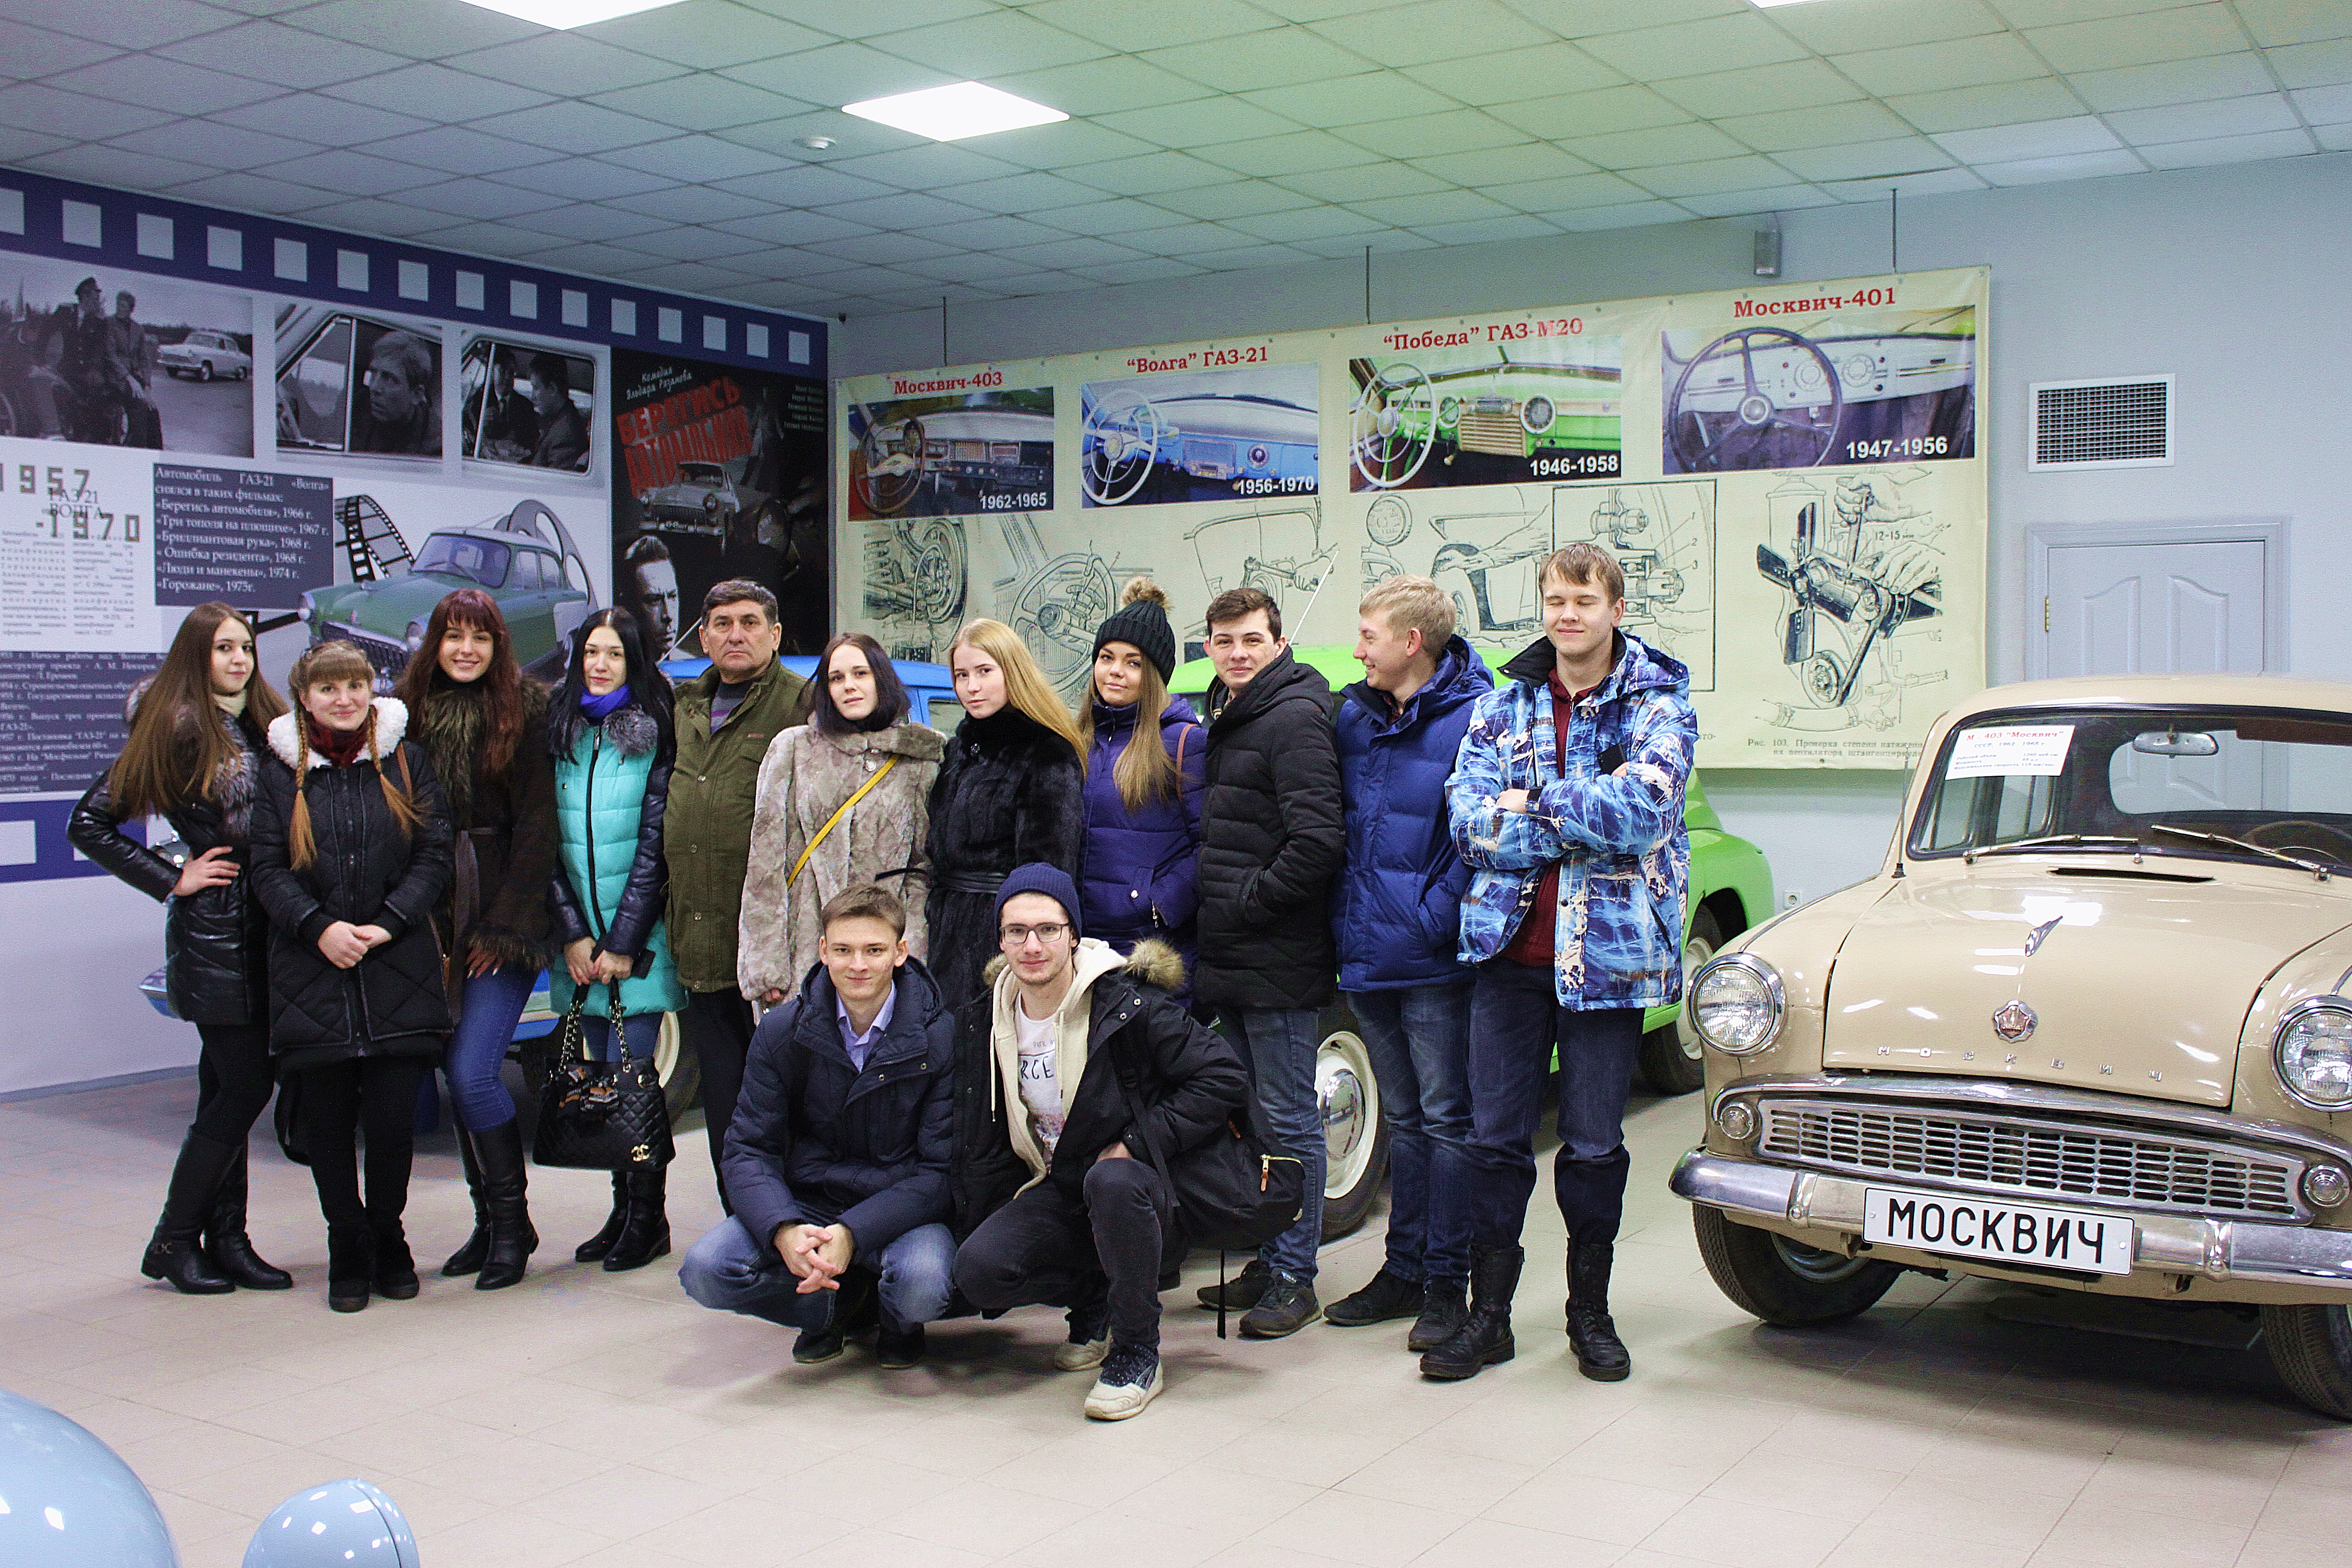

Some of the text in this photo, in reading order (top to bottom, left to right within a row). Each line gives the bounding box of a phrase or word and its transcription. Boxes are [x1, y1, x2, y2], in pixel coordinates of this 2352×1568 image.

[1734, 287, 1896, 318] Москвич-401
[1383, 318, 1583, 350] “Победа” ГАЗ-М20
[1127, 346, 1268, 373] “Волга” ГАЗ-21
[893, 372, 1003, 396] Москвич-403
[617, 376, 740, 444] БЕРЕГИСЬ
[624, 405, 754, 498] АВТОМОБИЛЯ
[1846, 436, 1948, 459] 1947-1956
[1530, 455, 1618, 476] 1946-1958
[156, 466, 329, 490] Автомобиль ГАЗ-21 «Волга»
[1238, 476, 1314, 495] 1956-1970
[194, 488, 201, 496] в
[203, 488, 233, 499] таких
[980, 492, 1047, 510] 1962-1965
[156, 499, 211, 514] «Берегись
[283, 507, 304, 519] 1966
[305, 511, 313, 519] г.
[156, 514, 183, 529] «Три
[186, 519, 223, 529] тополя
[225, 521, 239, 529] на
[299, 524, 320, 535] 1967
[281, 537, 302, 549] 1968
[1691, 538, 1697, 546] 2
[1875, 530, 1900, 541] 12-15
[164, 547, 210, 560] Ошибка
[157, 562, 195, 575] «Люди
[196, 566, 205, 575] и
[269, 567, 290, 578] 1974
[1692, 560, 1697, 569] 3
[1796, 740, 1837, 748] Проверка
[1877, 1045, 2162, 1082] МОСКВИЧ
[1887, 1197, 2105, 1264] МОСКВИЧ
